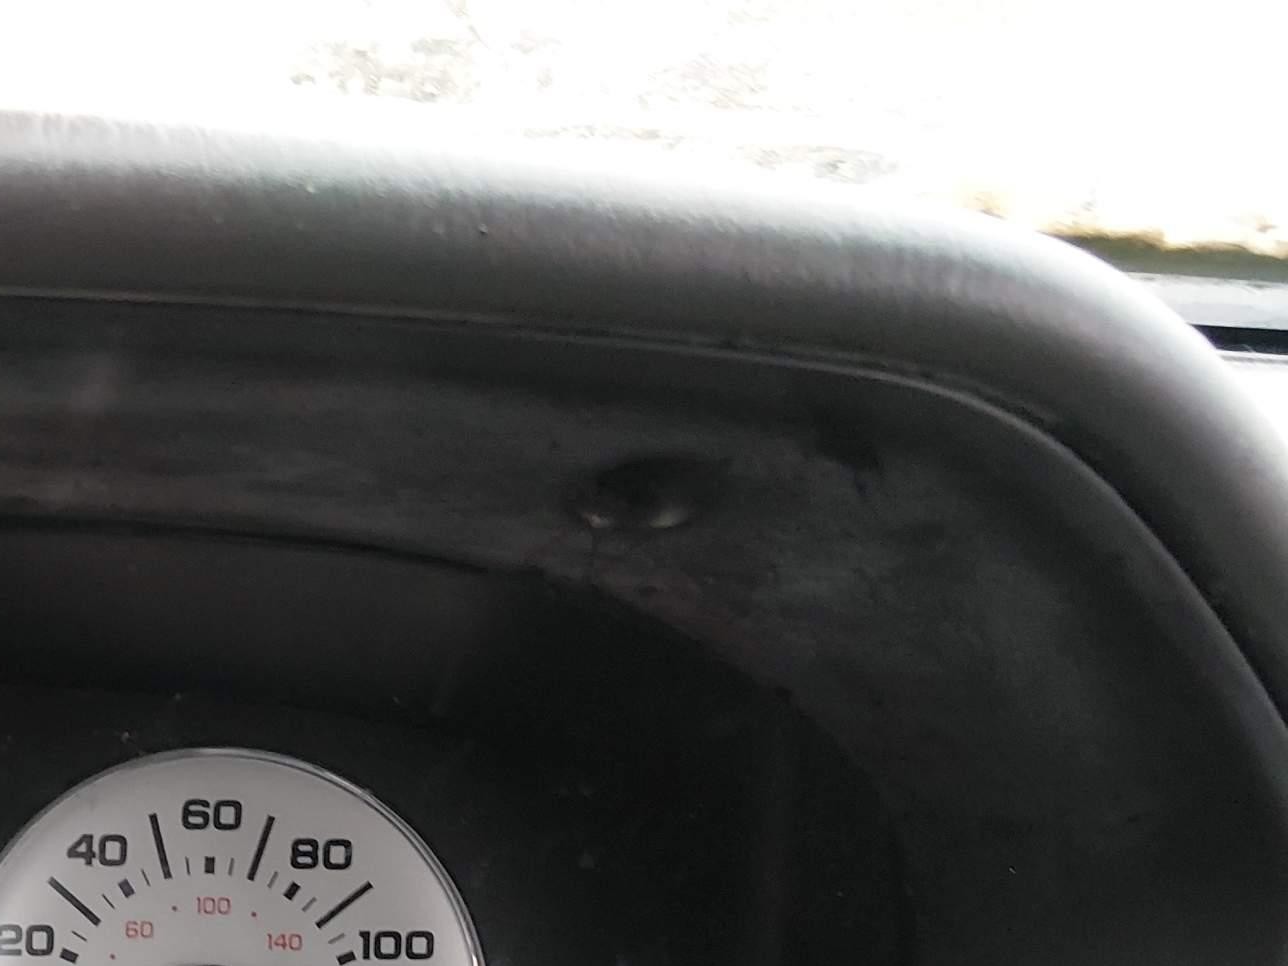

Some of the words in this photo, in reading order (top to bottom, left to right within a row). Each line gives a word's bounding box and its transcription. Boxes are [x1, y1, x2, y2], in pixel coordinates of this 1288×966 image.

[182, 799, 242, 830] 60
[67, 834, 127, 866] 40
[291, 838, 352, 870] 80
[197, 897, 231, 915] 100
[126, 921, 153, 938] 60
[268, 934, 302, 950] 140
[359, 931, 434, 960] 100
